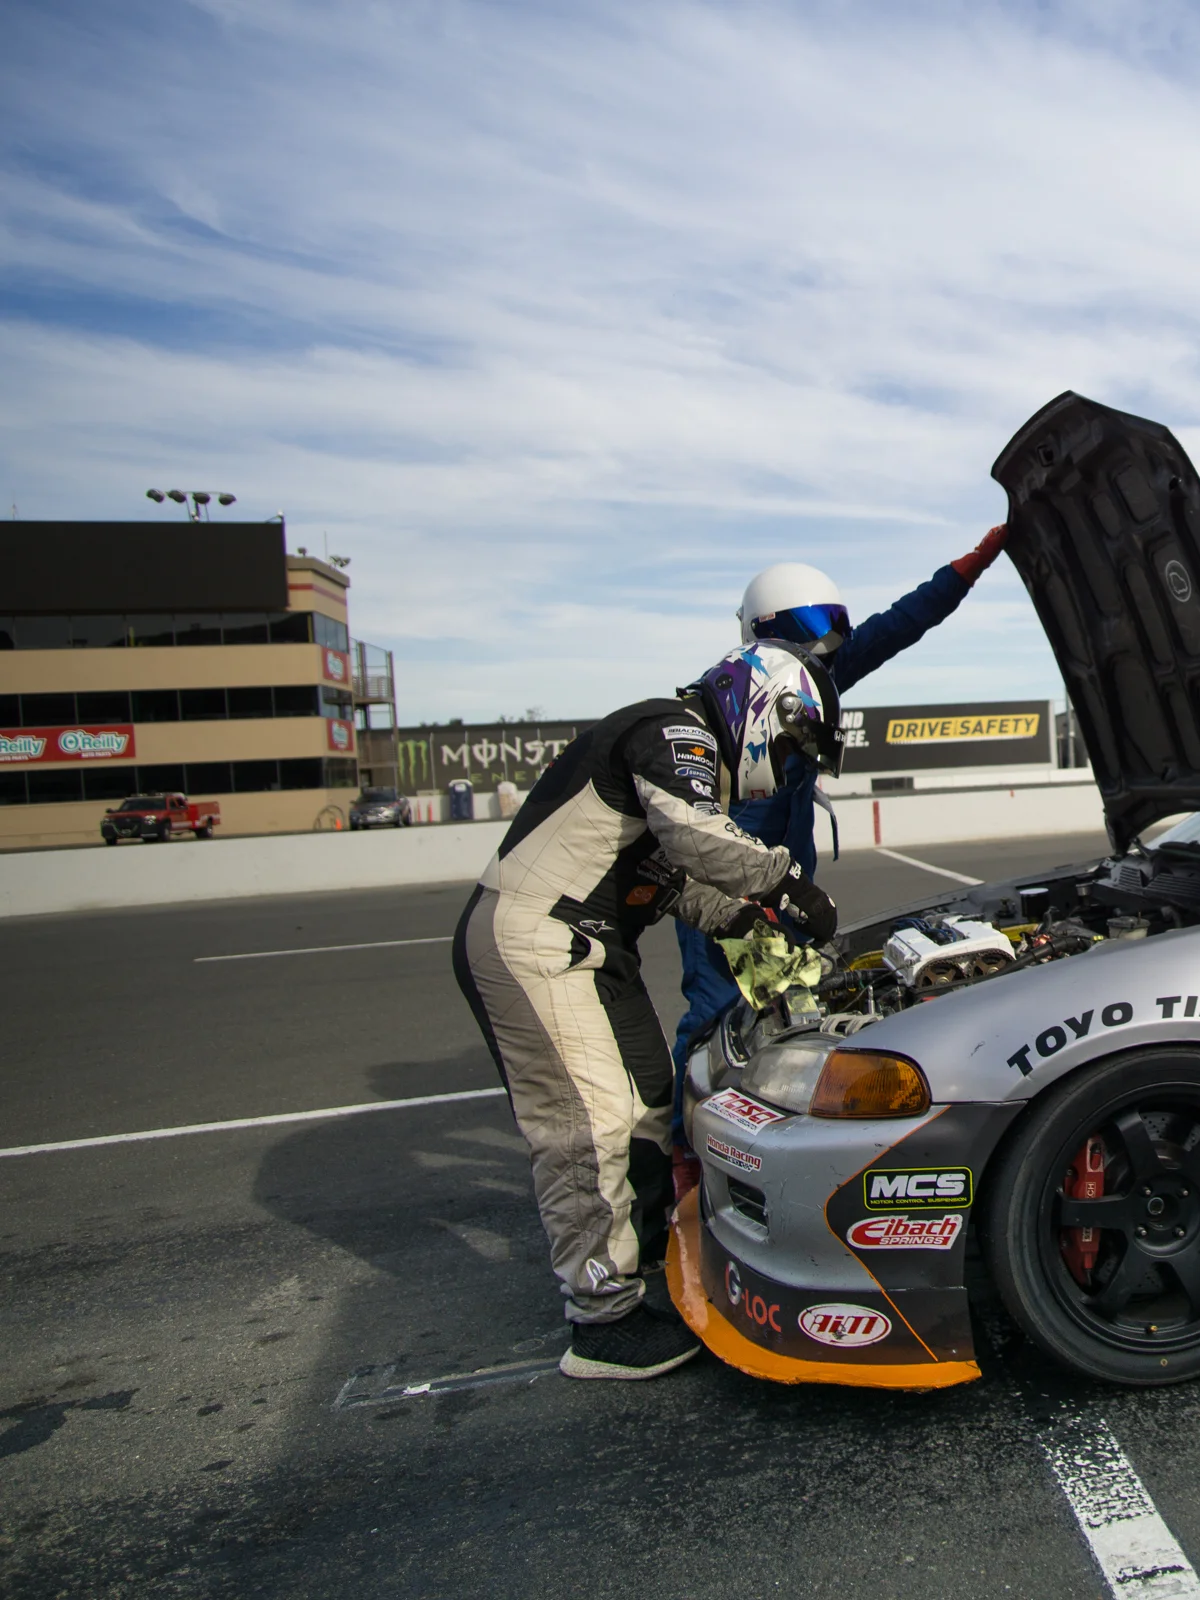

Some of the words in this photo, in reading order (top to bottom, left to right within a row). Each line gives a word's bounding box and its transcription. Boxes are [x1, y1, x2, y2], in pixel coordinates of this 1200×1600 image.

[840, 711, 864, 729] ND
[891, 720, 952, 738] DRIVE
[959, 717, 1036, 735] SAFETY
[0, 736, 44, 754] Reilly
[61, 731, 126, 752] O'Reilly
[845, 729, 870, 748] EE.
[441, 736, 570, 769] MONST
[470, 770, 540, 784] ENE
[1006, 1002, 1134, 1077] TOYO
[708, 1135, 730, 1155] Honda
[731, 1147, 761, 1169] Racing
[870, 1173, 966, 1198] MCS
[852, 1217, 958, 1245] Eibach
[879, 1236, 944, 1245] SPRINGS
